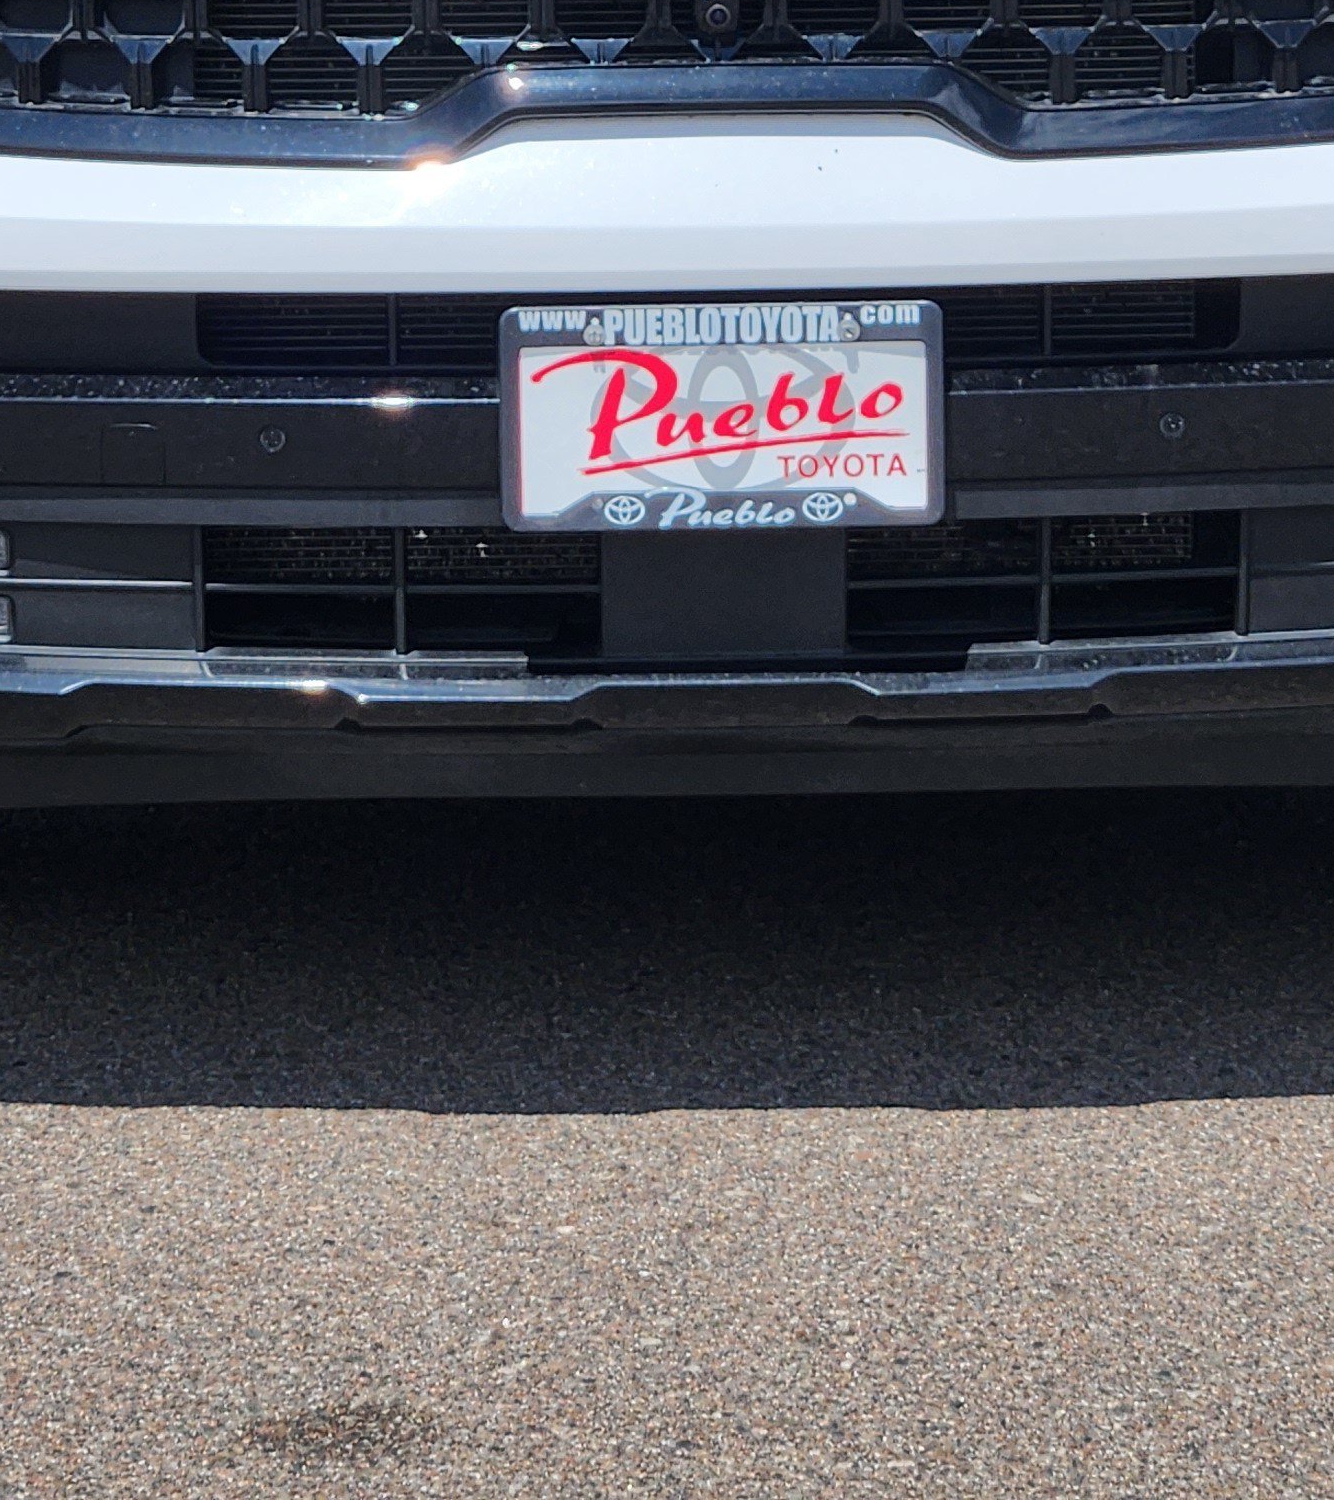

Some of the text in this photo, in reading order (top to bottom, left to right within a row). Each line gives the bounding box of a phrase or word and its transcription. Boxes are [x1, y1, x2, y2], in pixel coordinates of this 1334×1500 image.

[532, 349, 903, 460] Pueblo
[777, 453, 907, 478] TOYOTA
[644, 487, 795, 529] Pueblo
